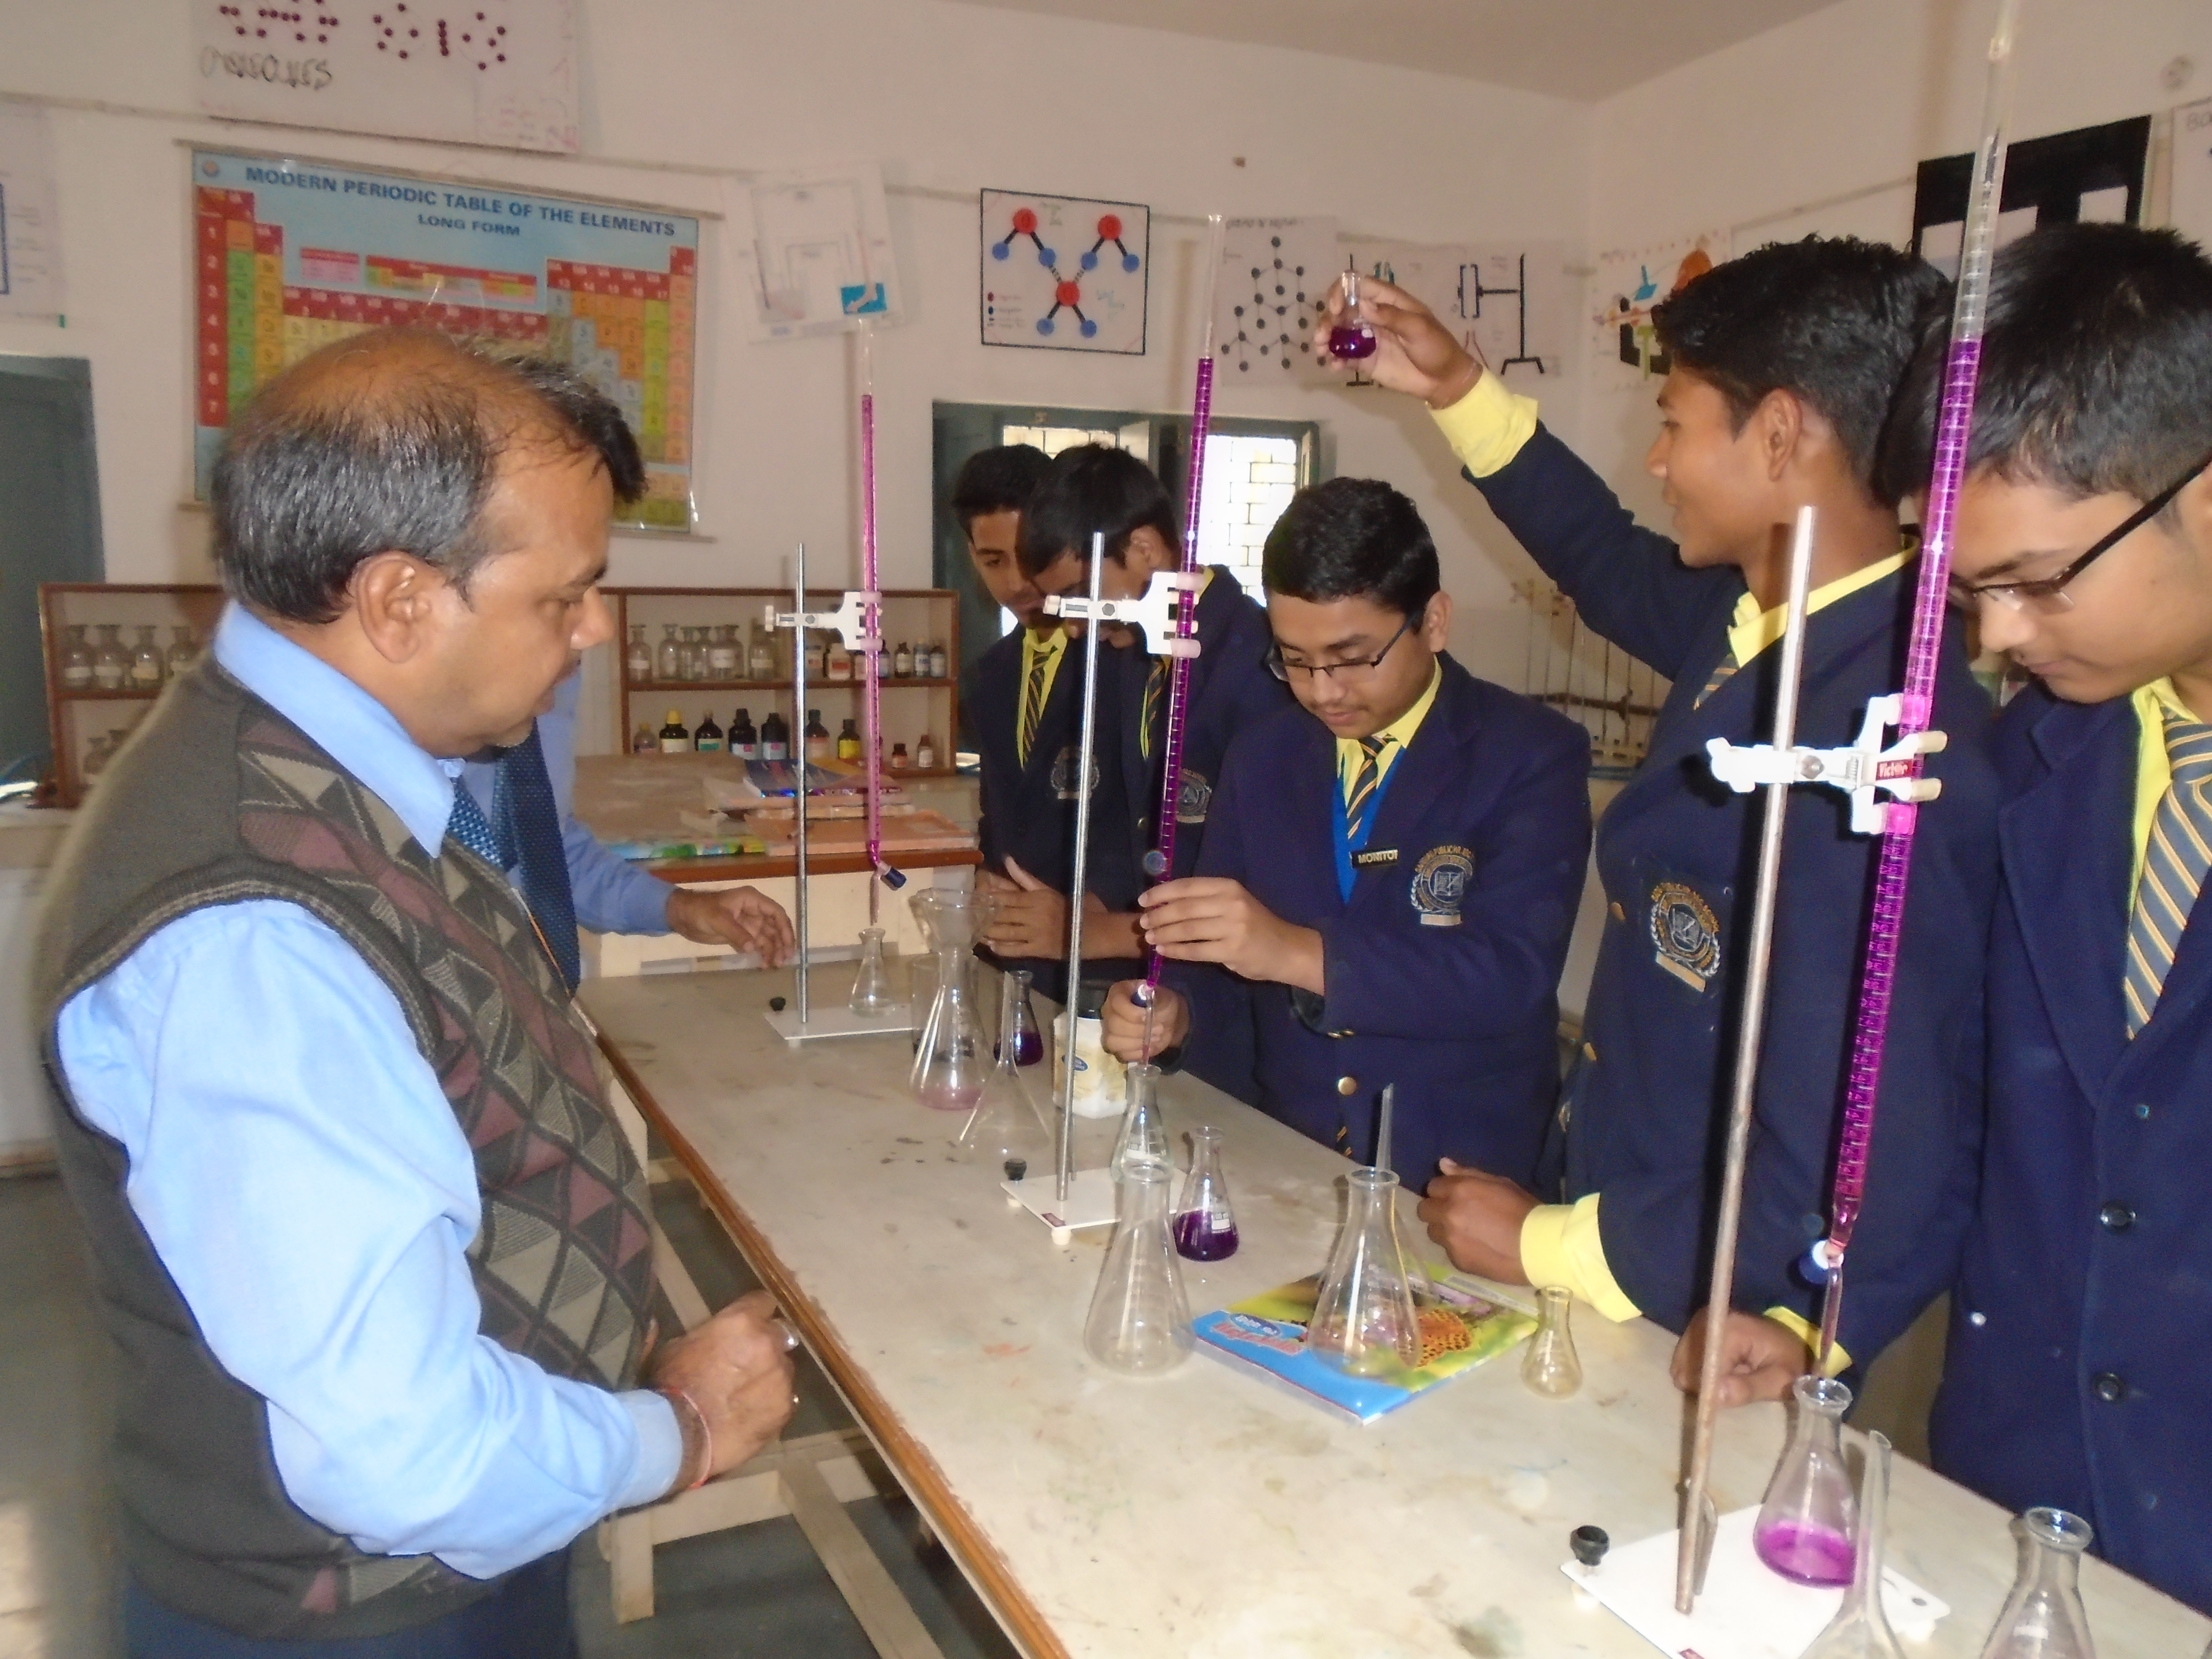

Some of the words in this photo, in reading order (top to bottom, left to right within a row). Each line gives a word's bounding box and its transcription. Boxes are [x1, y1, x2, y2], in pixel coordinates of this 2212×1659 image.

[246, 167, 337, 192] MODERN
[343, 180, 437, 205] PERIODIC
[444, 193, 502, 214] TABLE
[509, 204, 533, 218] OF
[540, 207, 574, 224] THE
[580, 212, 675, 236] ELEMENTS
[418, 214, 466, 230] LONG
[471, 221, 520, 236] FORM
